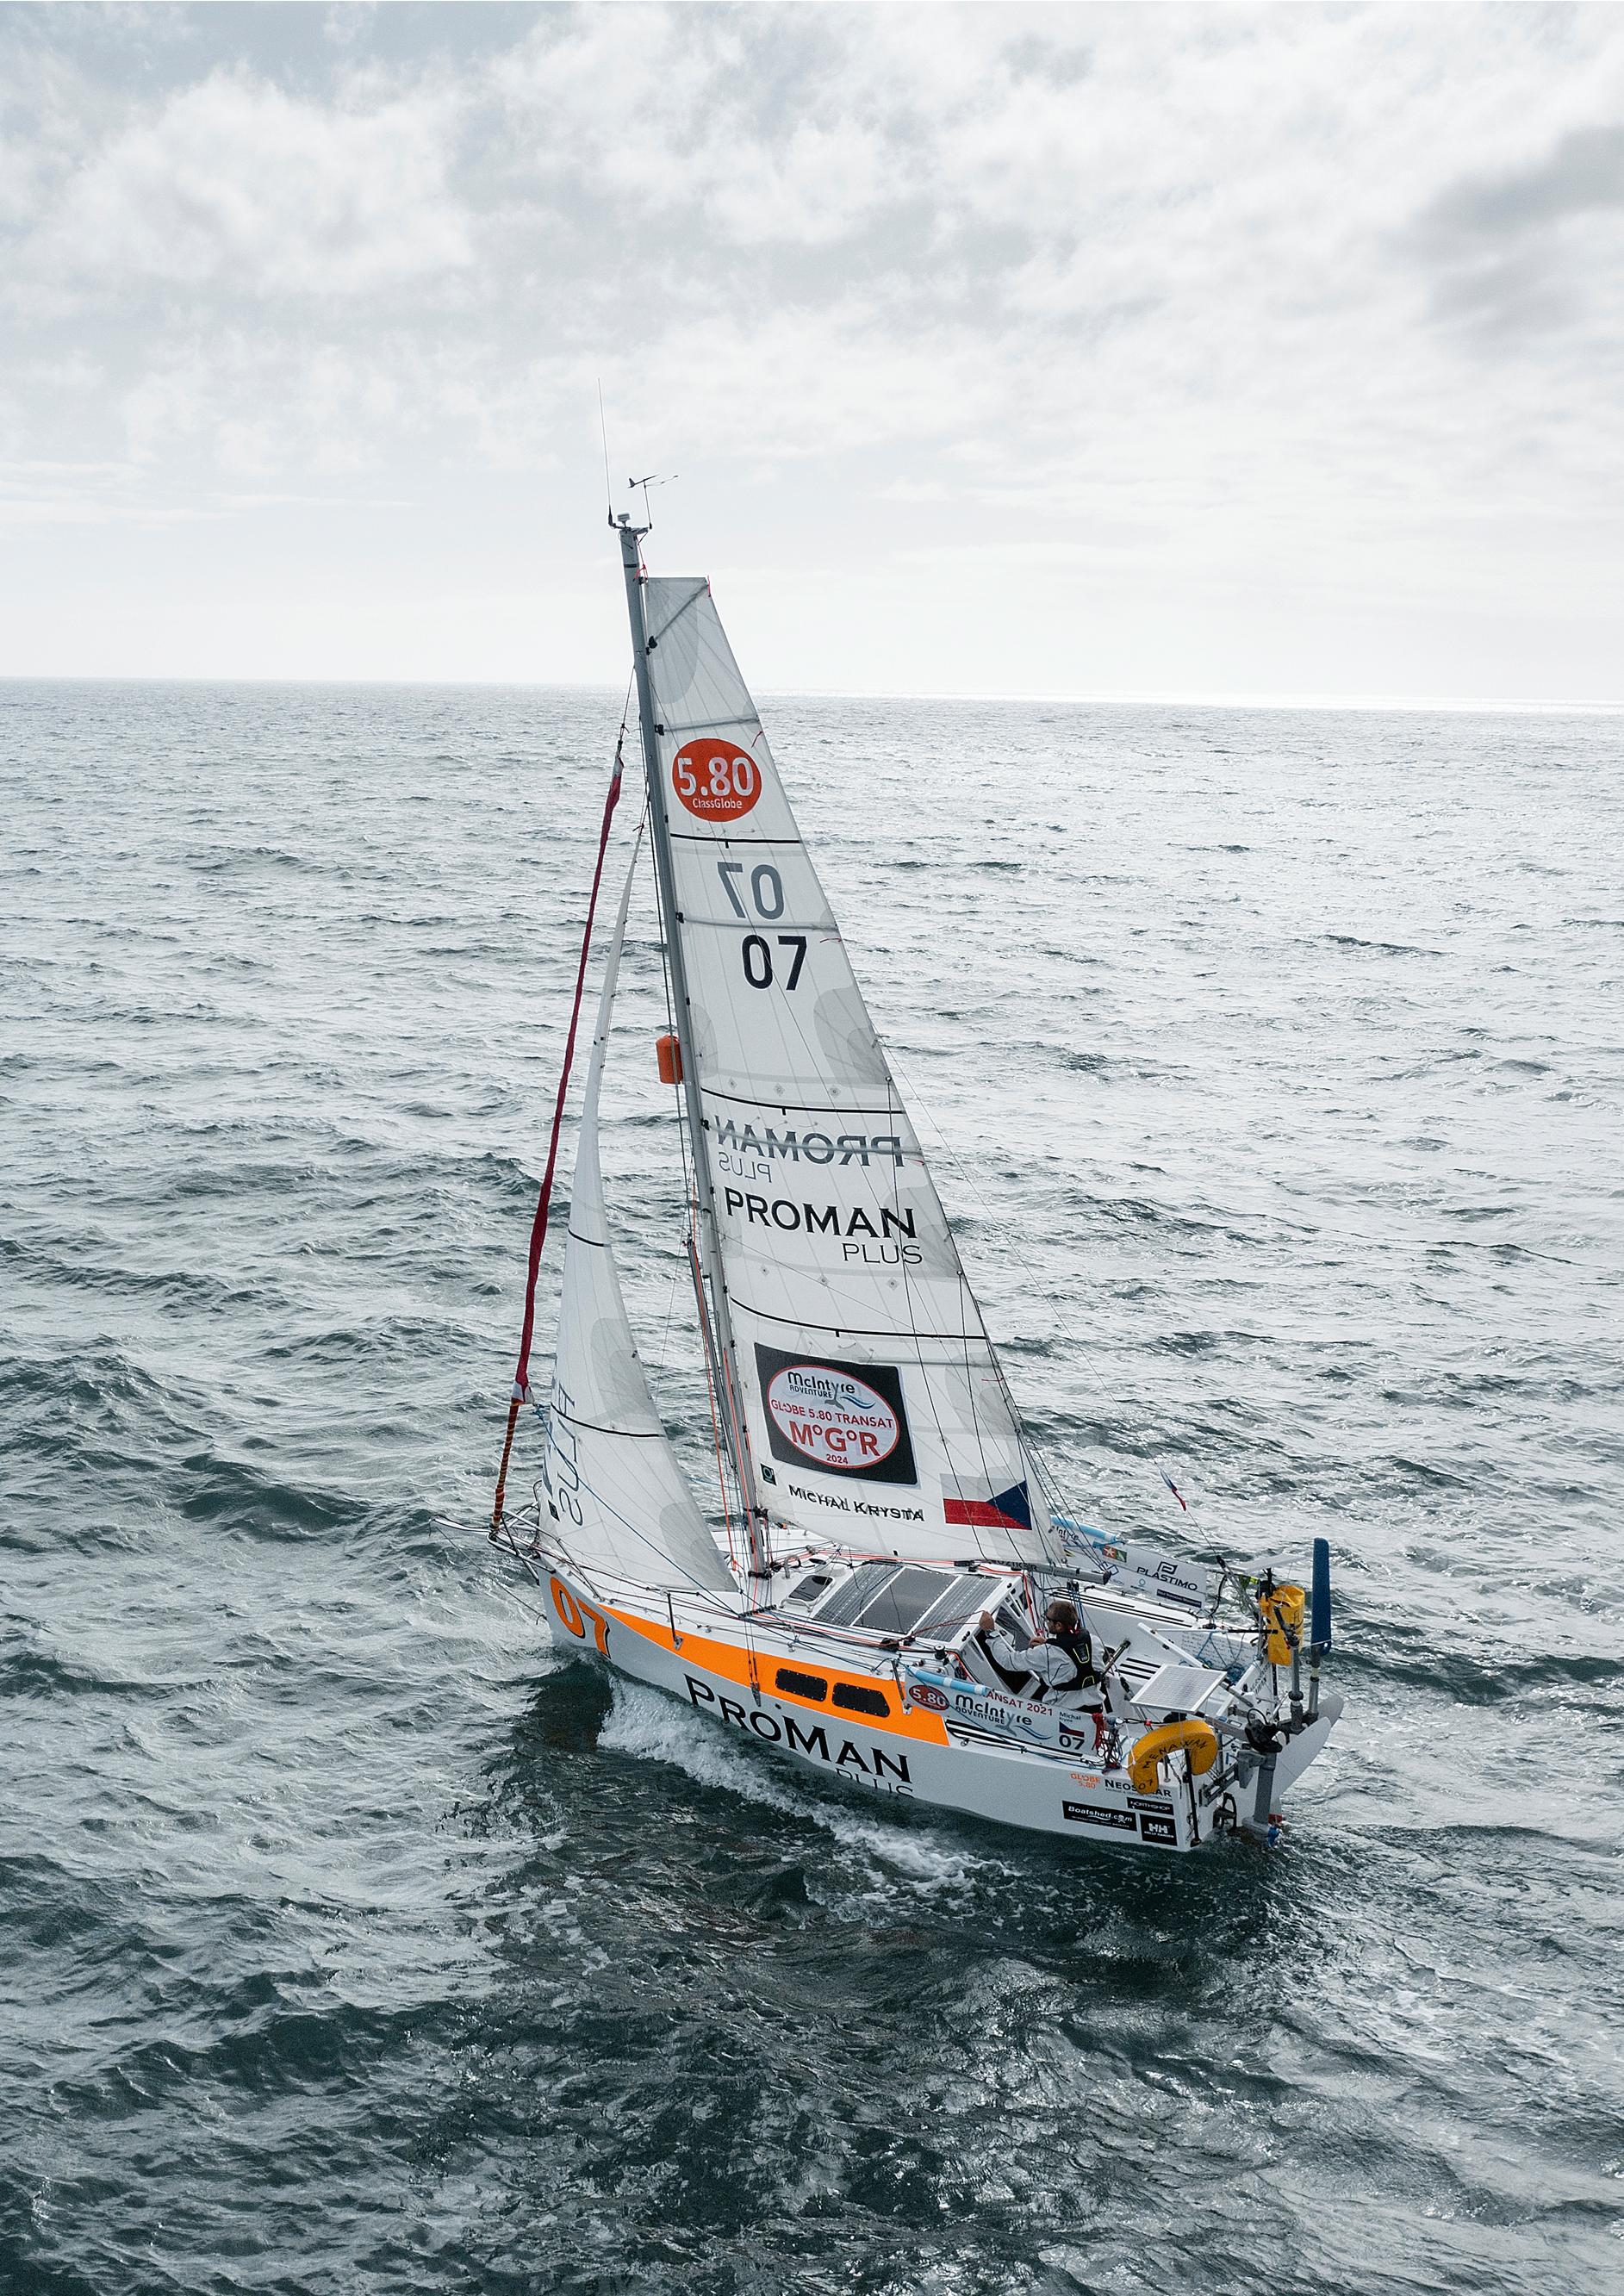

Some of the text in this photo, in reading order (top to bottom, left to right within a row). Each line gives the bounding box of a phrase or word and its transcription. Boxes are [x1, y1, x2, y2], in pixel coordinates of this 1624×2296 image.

[676, 757, 754, 797] 5.80
[692, 798, 743, 810] ClassGlobe
[742, 935, 807, 991] 07
[724, 1186, 918, 1239] PROMAN
[842, 1243, 923, 1264] PLUS
[771, 1399, 893, 1428] GLOBE 5.80 TRANSAT
[826, 1453, 849, 1465] 2024
[788, 1484, 924, 1521] MICHAL KRYSTA
[1137, 1566, 1198, 1591] PLASTIMO
[550, 1577, 611, 1659] 07
[913, 1688, 946, 1707] 5.80
[983, 1689, 1053, 1716] ANSAT 2021
[683, 1673, 913, 1783] PROMAN
[1059, 1711, 1081, 1721] Michal
[1059, 1734, 1085, 1751] 07
[1104, 1779, 1172, 1797] NEOSAR
[1148, 1823, 1168, 1834] HH
